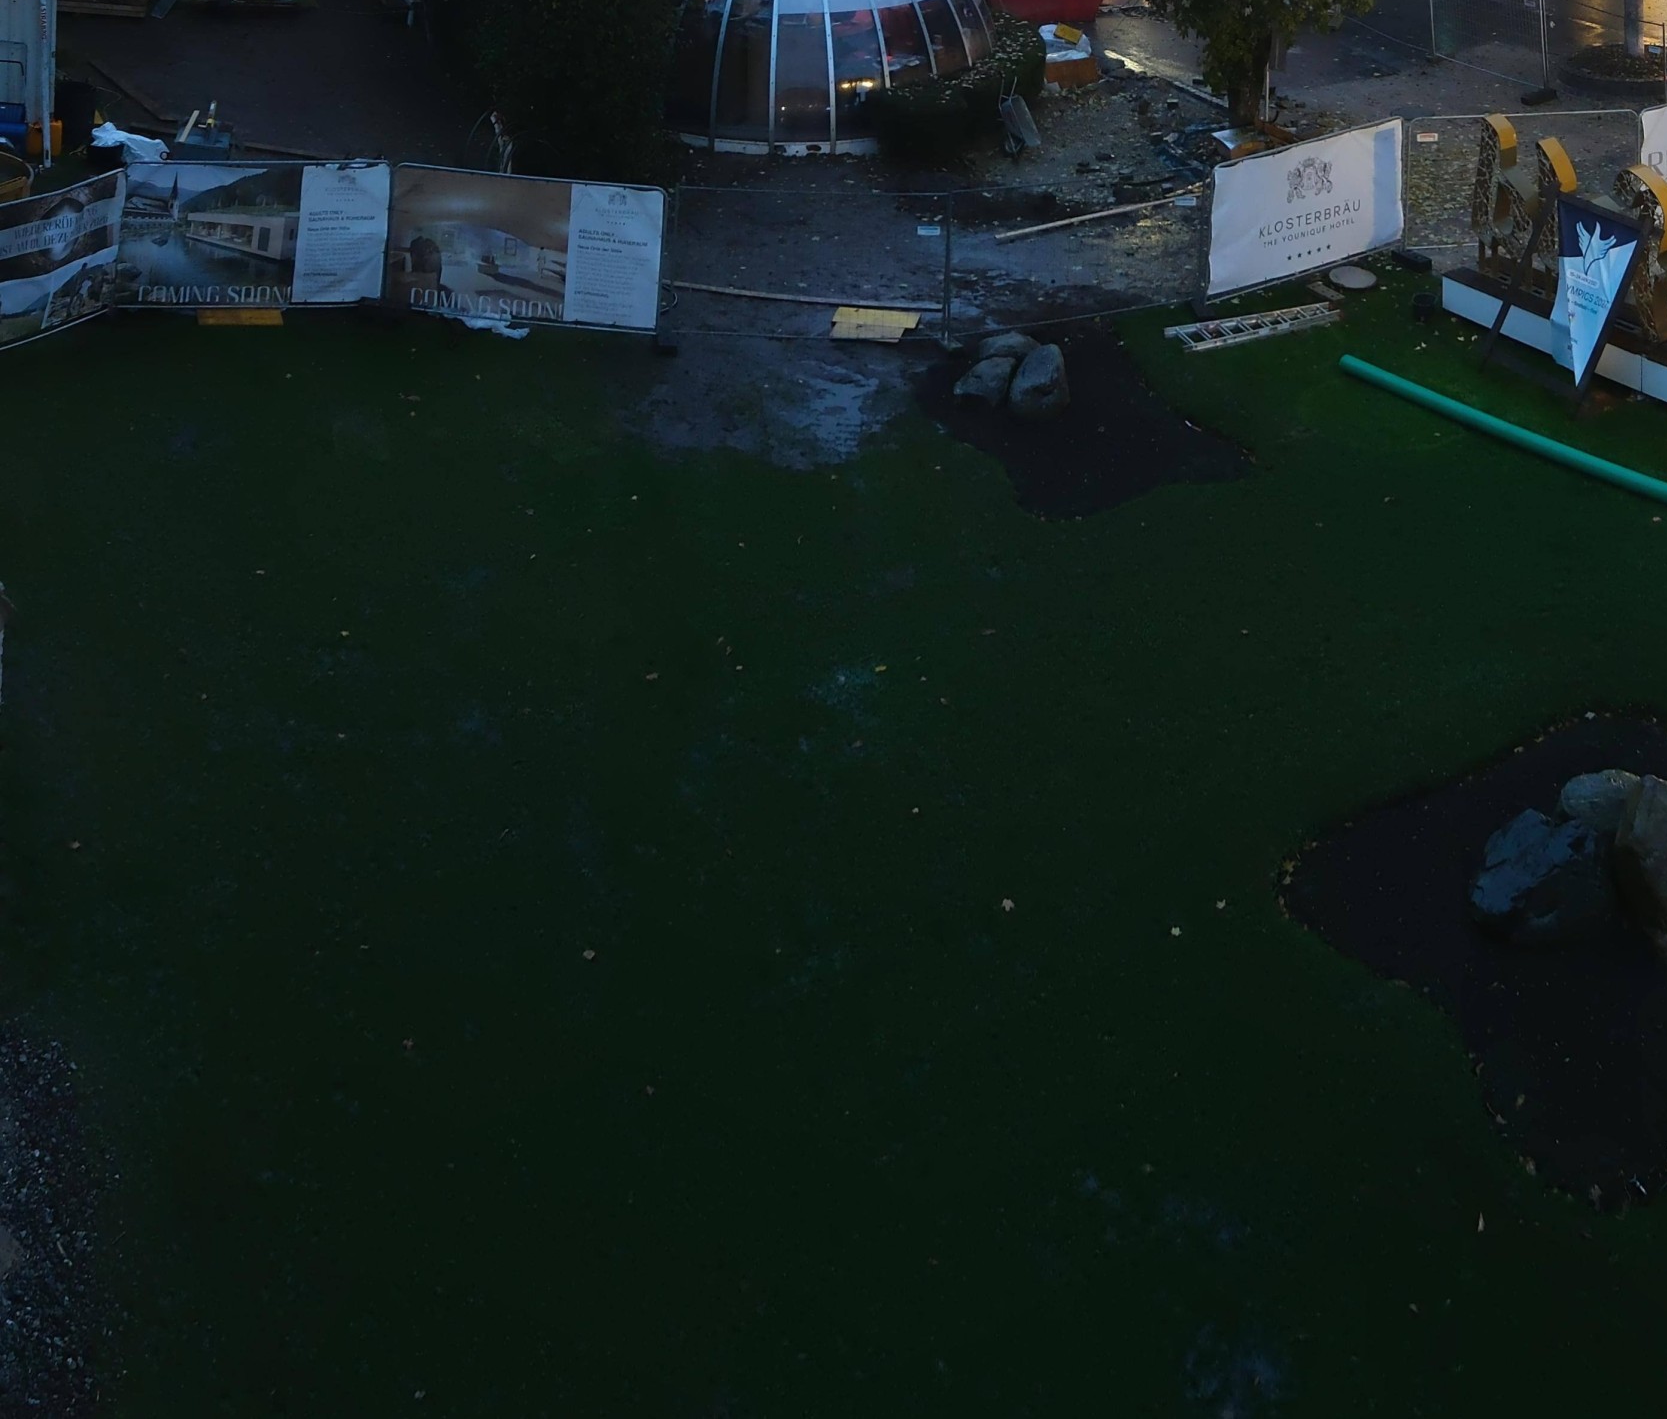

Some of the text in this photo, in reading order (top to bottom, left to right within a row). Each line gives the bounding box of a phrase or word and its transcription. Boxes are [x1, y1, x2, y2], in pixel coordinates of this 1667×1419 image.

[1258, 199, 1361, 240] KLOSTERBRÄU
[1263, 217, 1355, 249] THE YOUNIQUE HOTEL
[137, 284, 219, 303] COMING
[410, 287, 491, 314] COMING
